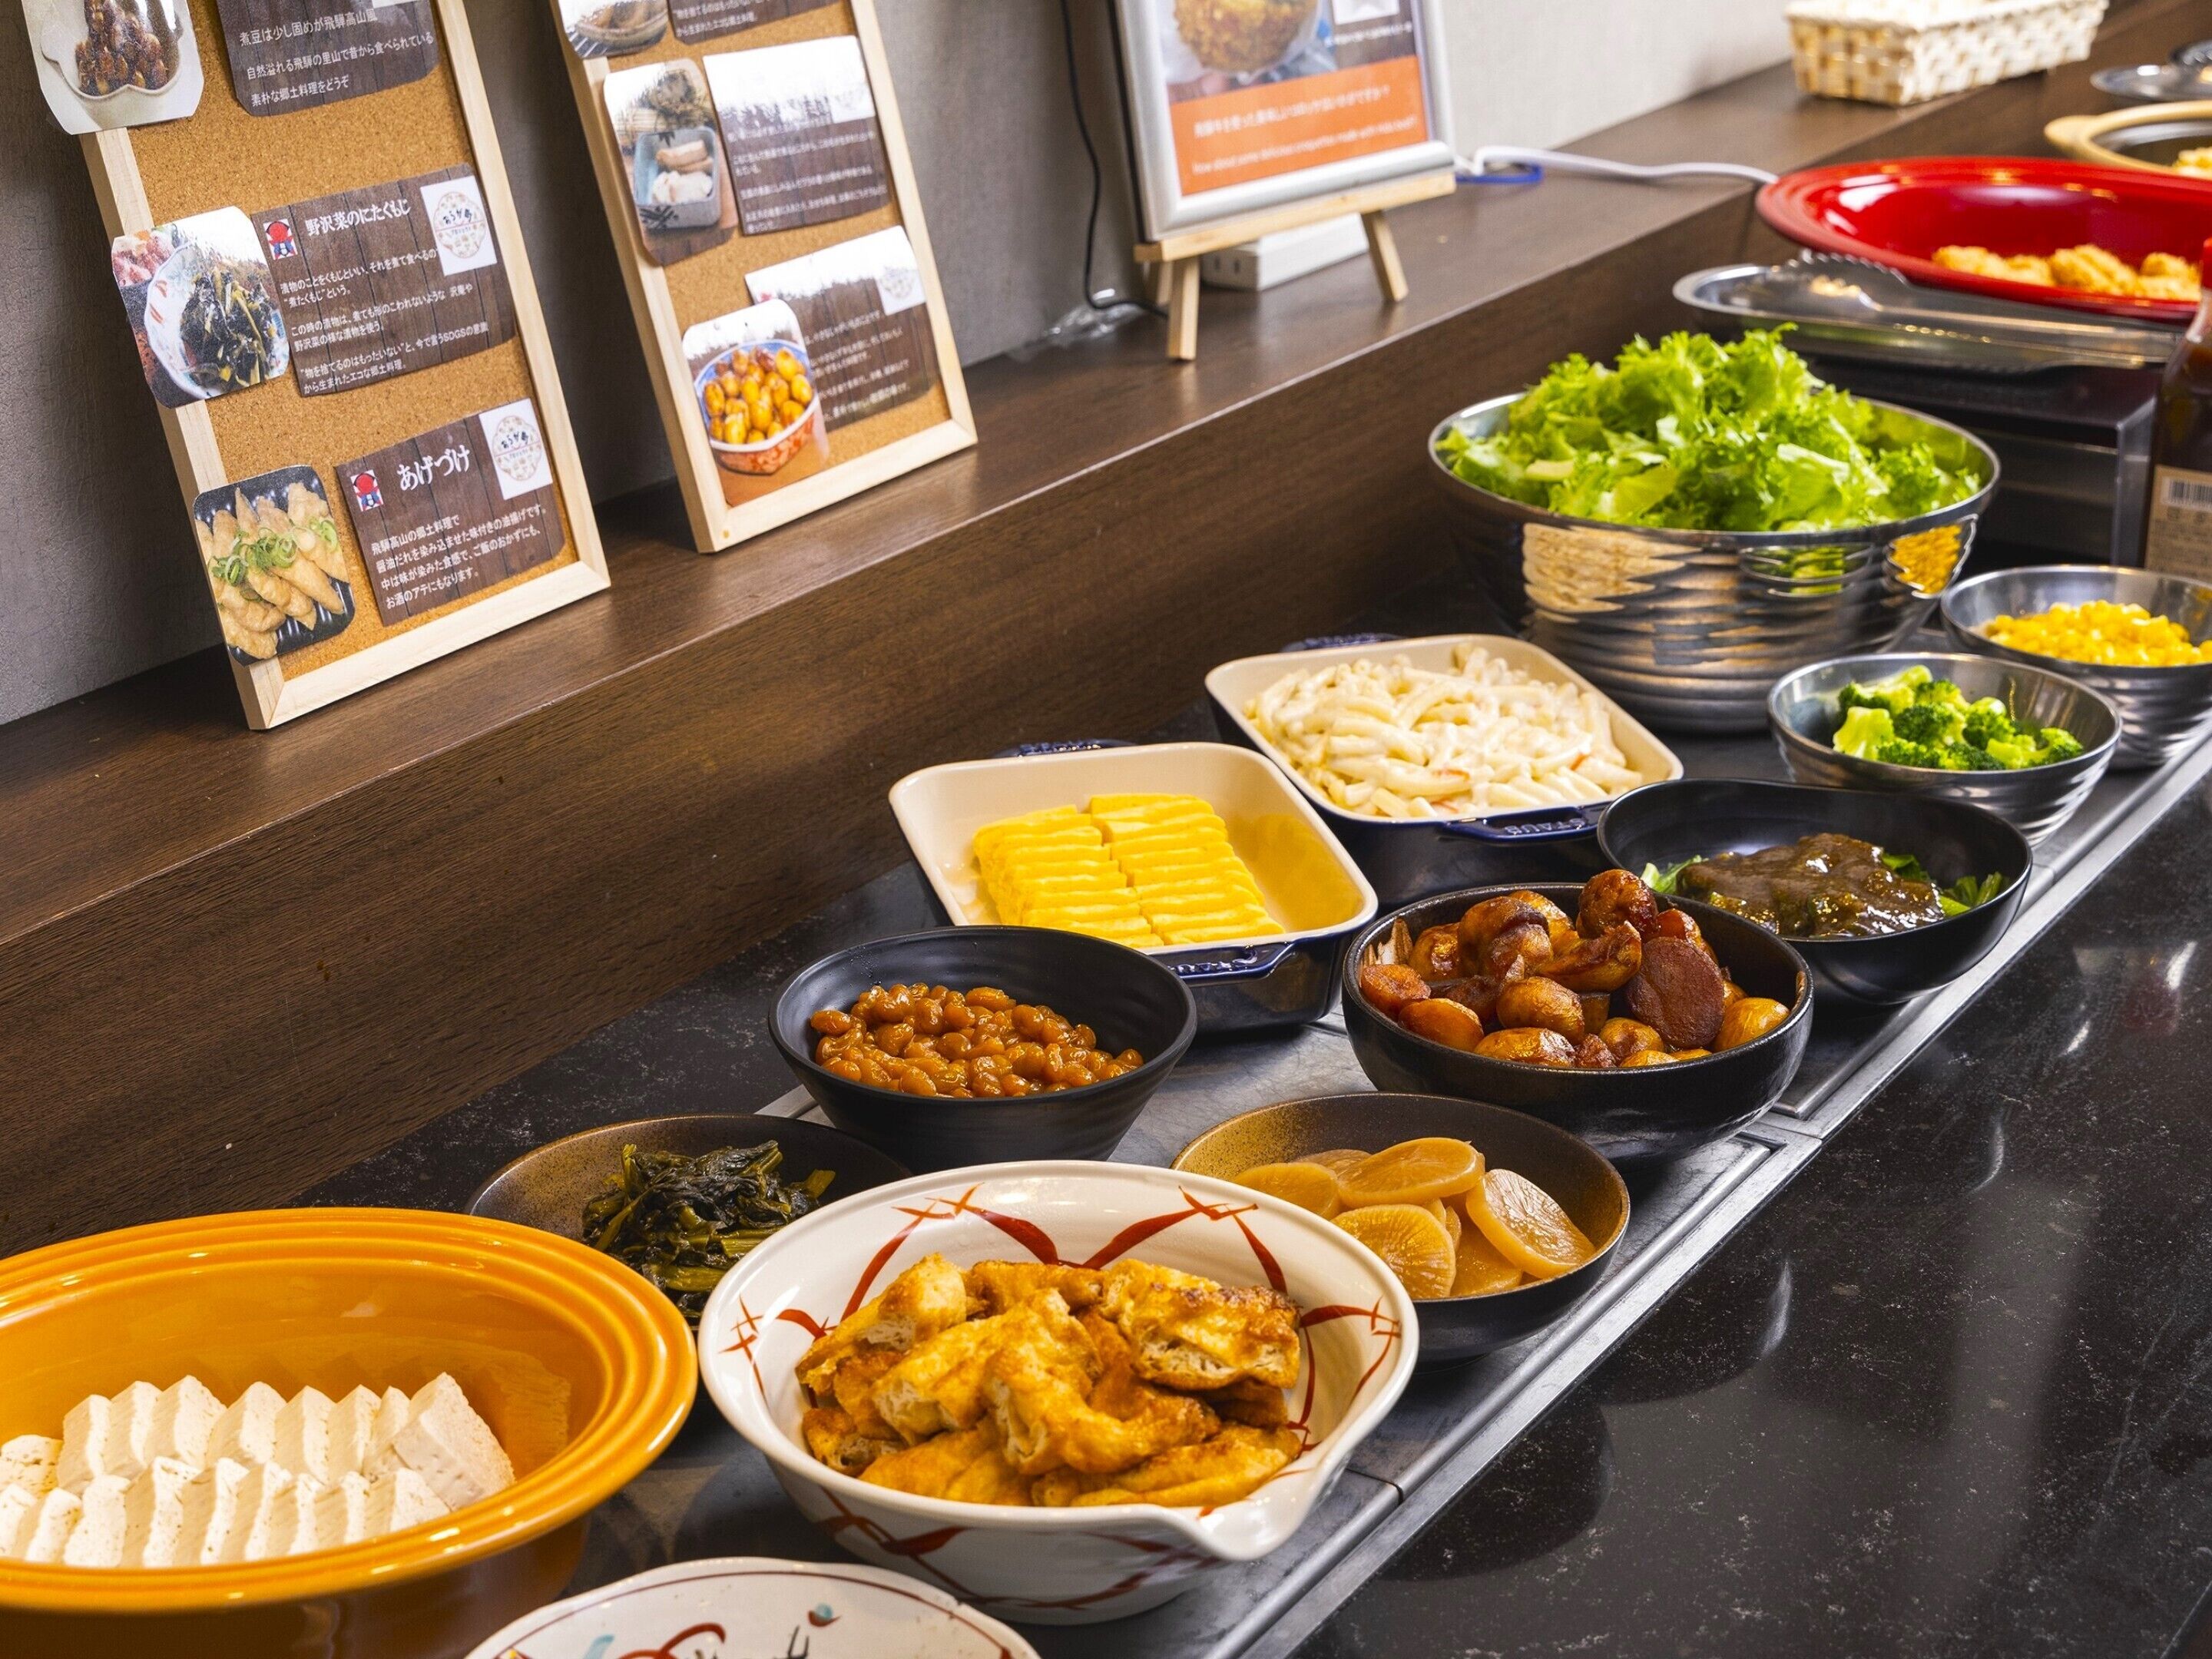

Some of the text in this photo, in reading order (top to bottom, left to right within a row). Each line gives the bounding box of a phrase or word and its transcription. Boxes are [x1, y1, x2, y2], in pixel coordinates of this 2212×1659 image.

[239, 9, 378, 47] 煮豆は少し固めが飛騨高山風
[247, 31, 434, 80] 自然溢れる飛騨の里山で昔から食べられている
[251, 75, 349, 107] 素朴な郷土料理をどうぞ
[305, 198, 412, 237] 野沢菜のにたくもじ
[396, 444, 470, 491] あげづけ
[1505, 818, 1585, 834] STAUB
